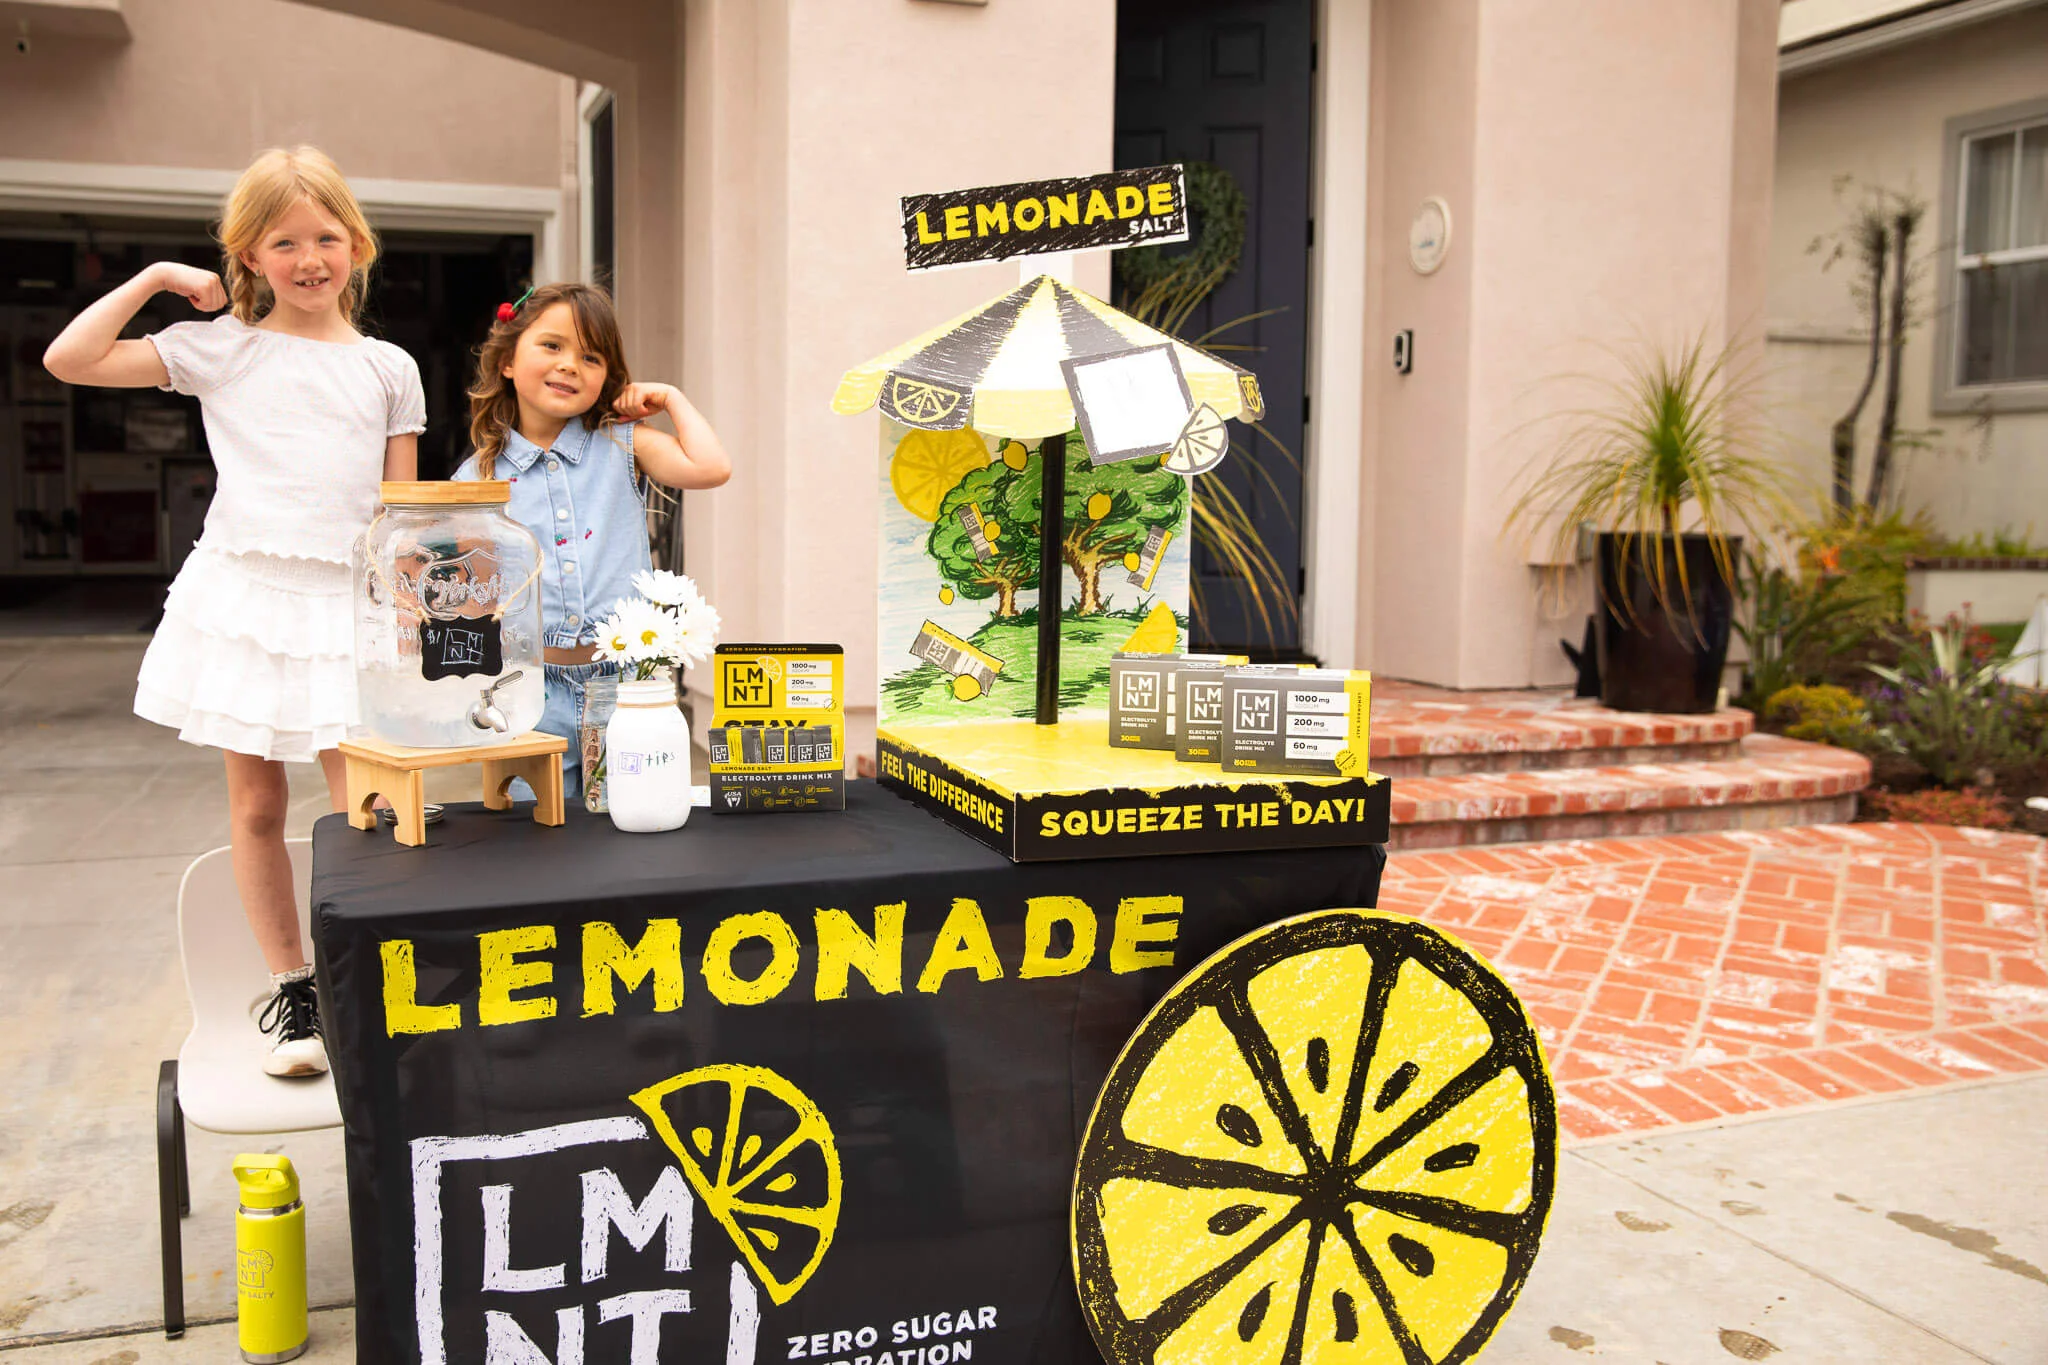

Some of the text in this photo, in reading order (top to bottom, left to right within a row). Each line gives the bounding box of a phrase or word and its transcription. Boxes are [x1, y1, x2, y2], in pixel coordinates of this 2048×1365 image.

[916, 182, 1175, 246] LEMONADE
[1128, 216, 1174, 236] SALT
[733, 667, 764, 683] LM
[1126, 676, 1153, 692] LM
[733, 685, 764, 702] NT
[1126, 692, 1153, 707] NT
[1194, 687, 1222, 702] LM
[1294, 694, 1318, 703] 1000
[1194, 703, 1222, 719] NT
[1241, 695, 1270, 712] LM
[1241, 711, 1270, 728] NT
[1294, 718, 1313, 726] 200
[800, 745, 813, 753] LM
[1293, 742, 1306, 750] 60
[645, 750, 676, 767] tips
[721, 772, 833, 782] ELECTROLYTE DRINK MIX
[881, 750, 1004, 834] FEEL THE DIFFERENCE
[1039, 798, 1366, 837] SQUEEZE THE DAY!
[379, 894, 1184, 1038] LEMONADE
[478, 1164, 695, 1293] LM
[241, 1269, 257, 1283] NT
[786, 1305, 998, 1360] ZERO SUGAR
